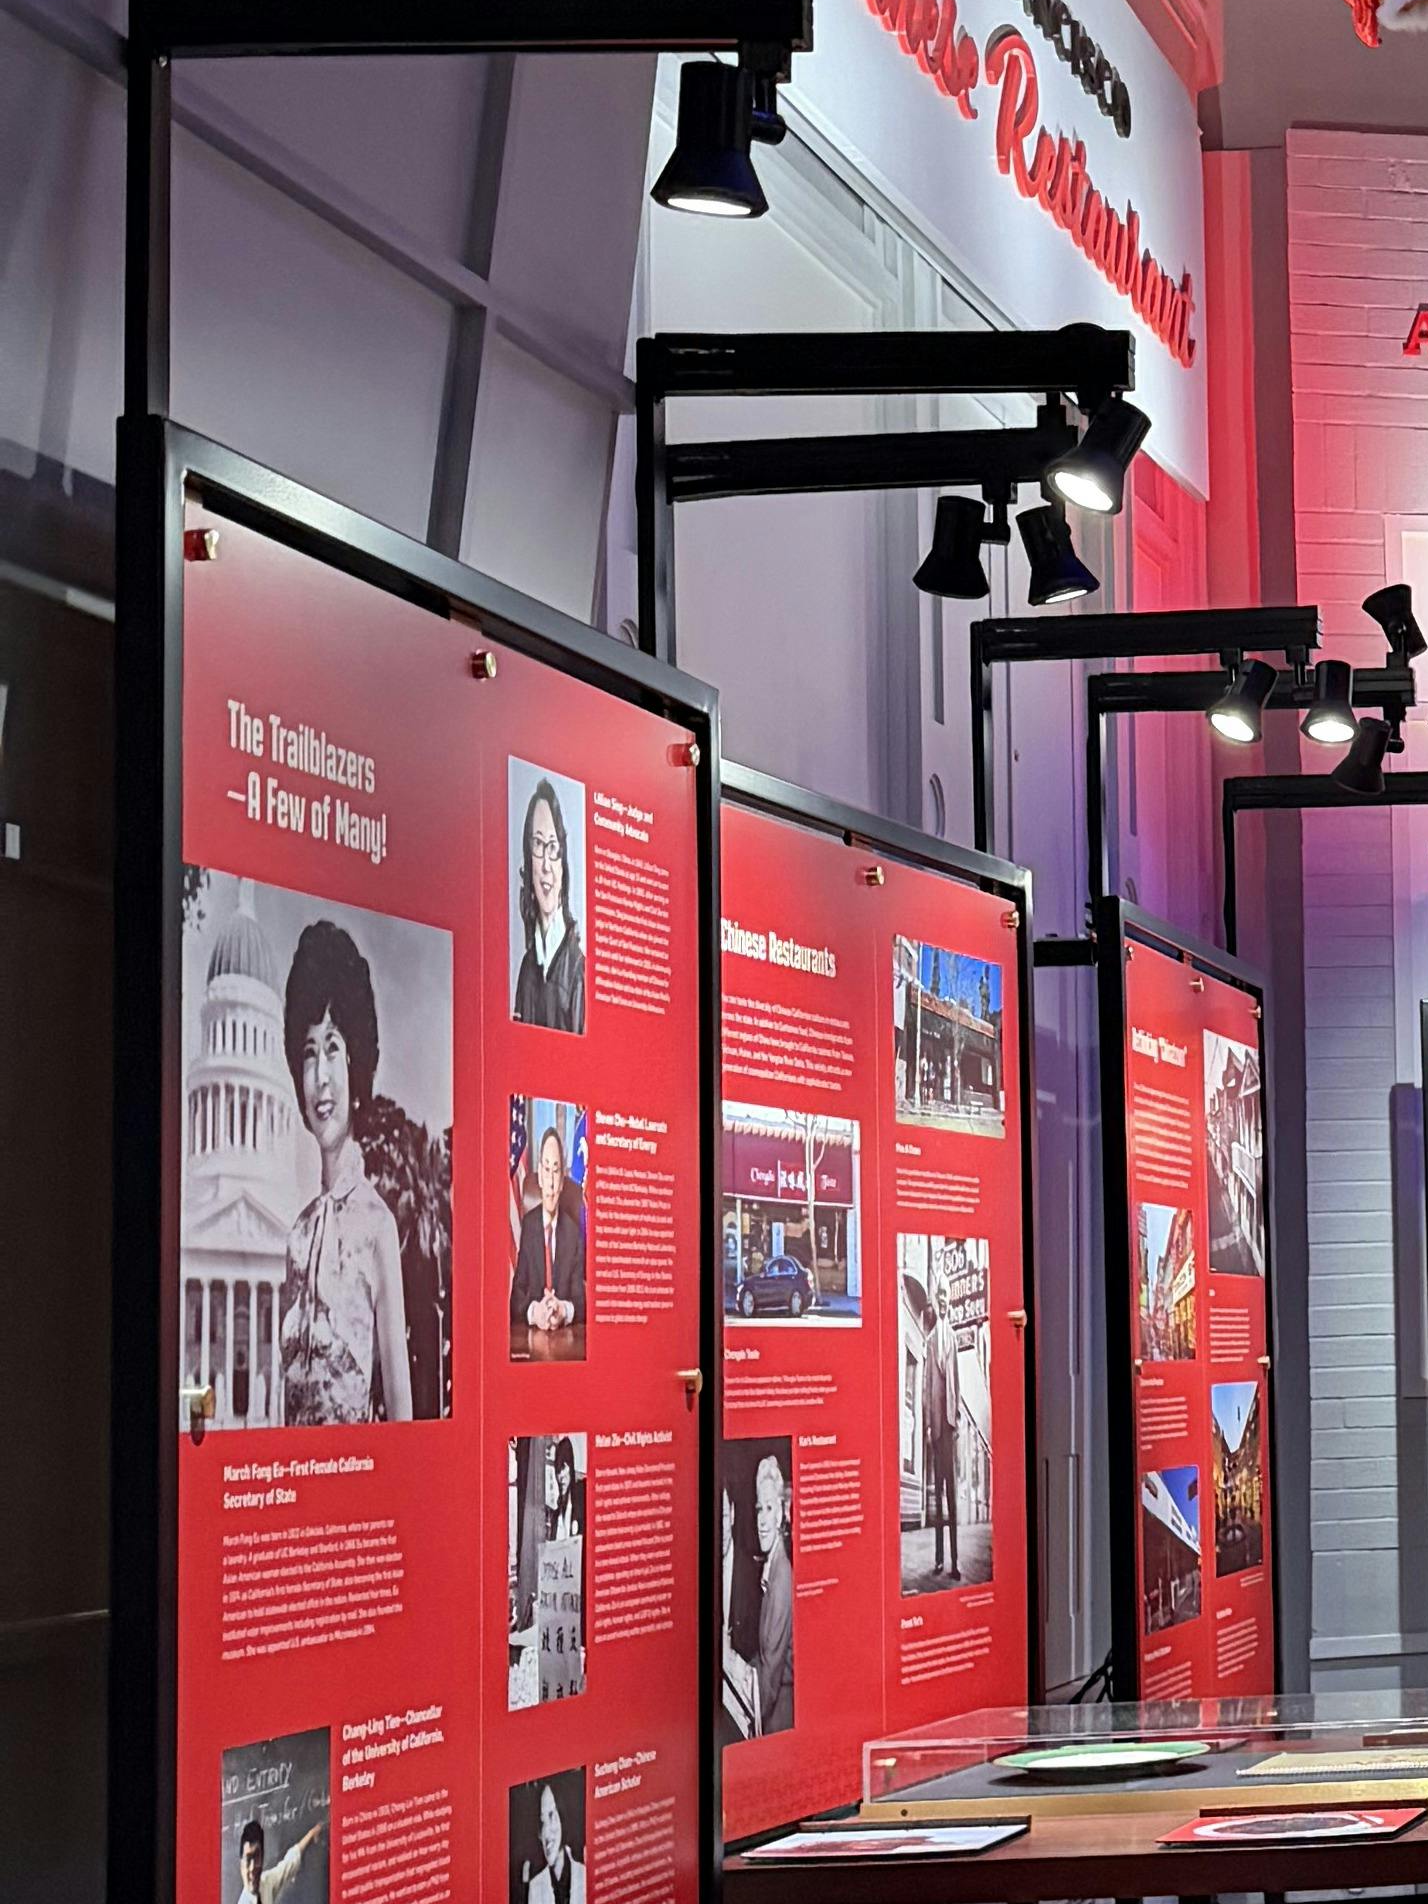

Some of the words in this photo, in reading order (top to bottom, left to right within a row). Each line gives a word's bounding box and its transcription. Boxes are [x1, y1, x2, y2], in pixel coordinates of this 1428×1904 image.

[985, 23, 1197, 369] Restaurant
[228, 699, 264, 757] The
[269, 714, 375, 793] Trailblazers
[267, 777, 306, 833] Few
[311, 794, 331, 841] of
[336, 799, 387, 864] Many!
[721, 917, 767, 961] Chinese
[768, 931, 837, 979] Restaurants
[338, 1456, 375, 1473] California
[223, 1492, 265, 1509] Secretary
[266, 1489, 275, 1505] of
[275, 1488, 297, 1504] State
[342, 1752, 351, 1766] of
[351, 1748, 364, 1764] the
[365, 1741, 400, 1761] University
[401, 1737, 409, 1752] of
[342, 1771, 376, 1792] Berkeley
